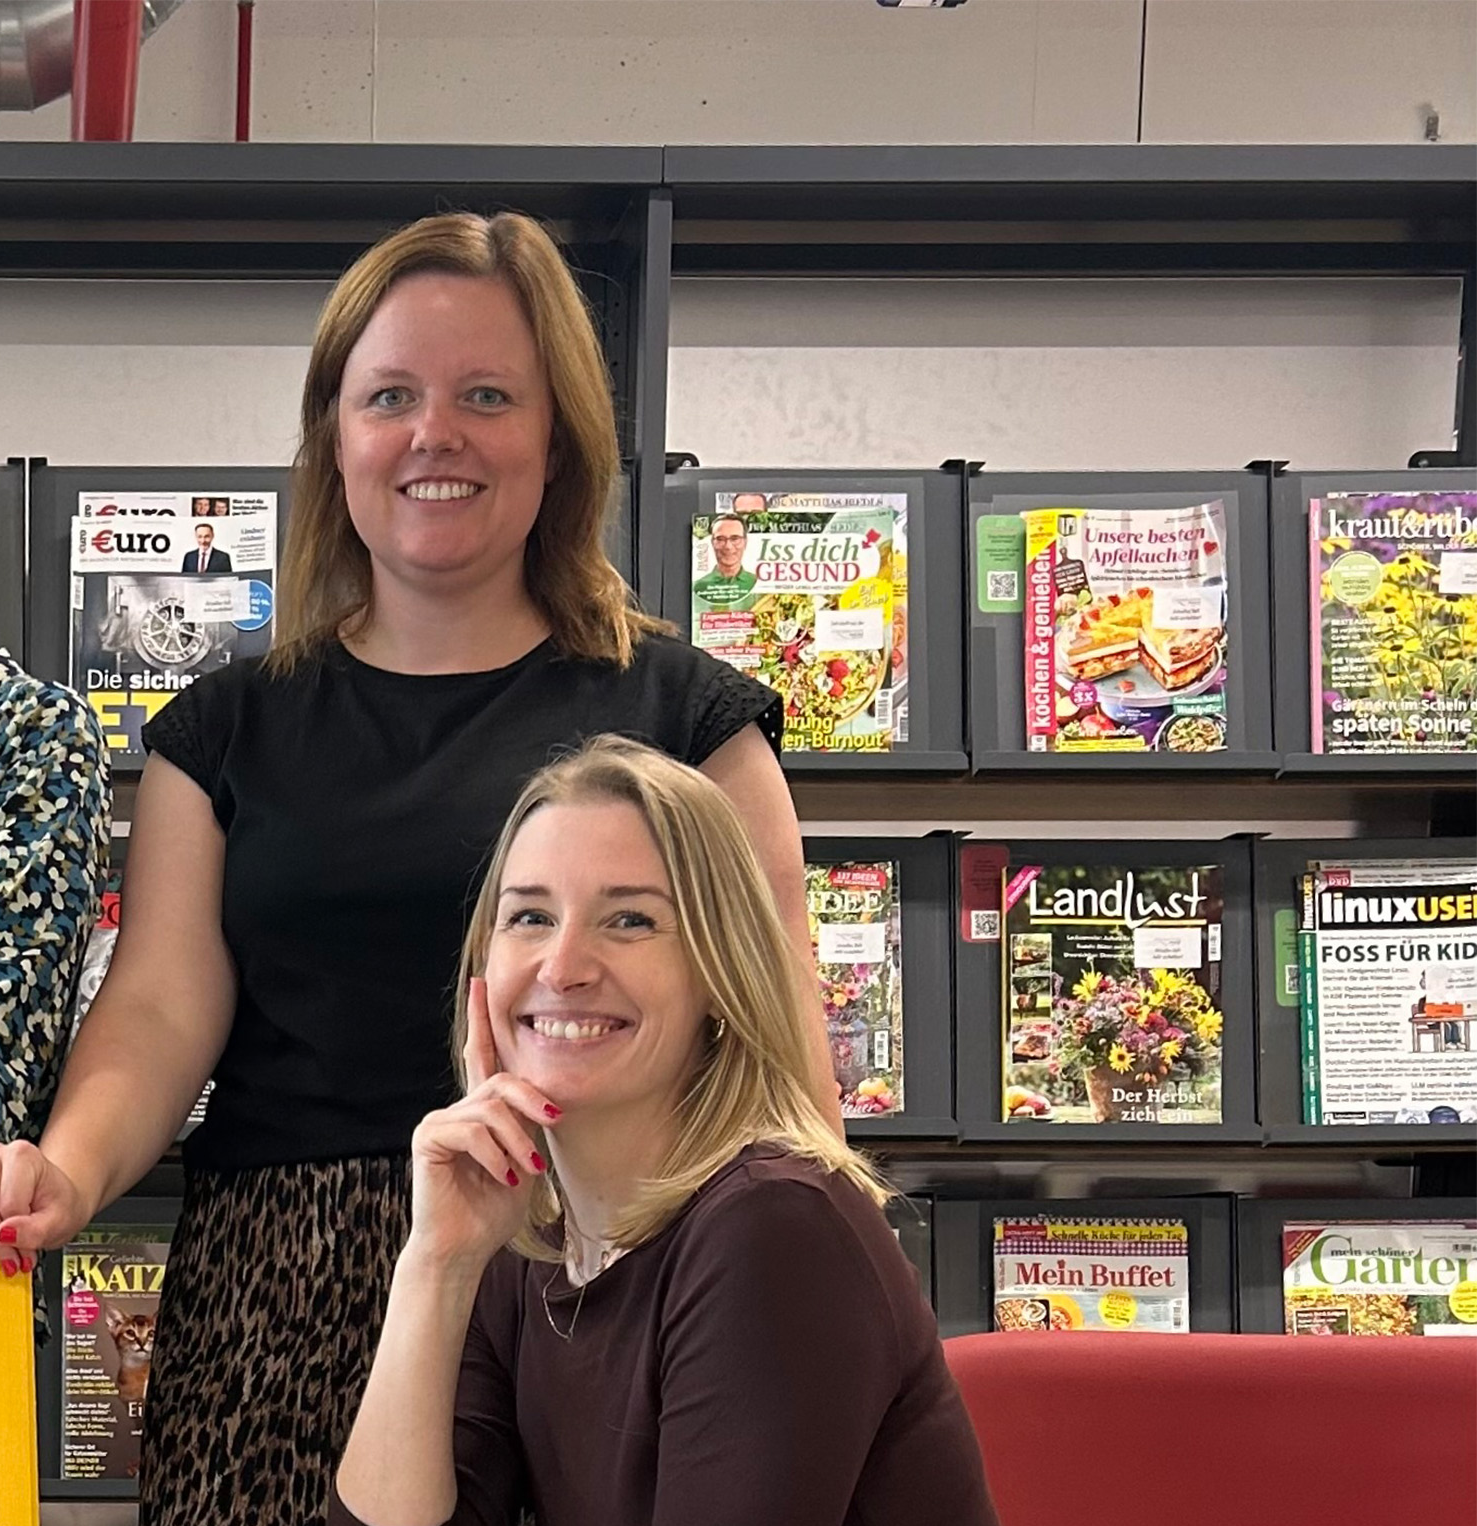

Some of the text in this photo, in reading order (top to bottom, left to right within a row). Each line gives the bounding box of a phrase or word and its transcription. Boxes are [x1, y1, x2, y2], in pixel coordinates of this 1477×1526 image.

[1328, 506, 1477, 540] kraut&rüb
[91, 529, 171, 554] €uro
[1085, 527, 1205, 544] Unsere besten
[758, 537, 859, 562] Iss dich
[1088, 547, 1199, 567] Apfelkuchen
[755, 562, 861, 582] GESUND
[1032, 638, 1051, 653] &
[87, 669, 122, 690] Die
[1031, 654, 1053, 728] kochen
[1332, 698, 1467, 712] Gärtnern im Schein
[1332, 714, 1472, 736] späten Sonne
[1322, 945, 1379, 963] FOSS
[1386, 940, 1431, 962] FÜR
[1112, 1087, 1202, 1104] Der Herbst
[1121, 1107, 1193, 1122] zieht ein
[1365, 1246, 1415, 1257] schöner
[1015, 1260, 1176, 1287] Mein Buffet
